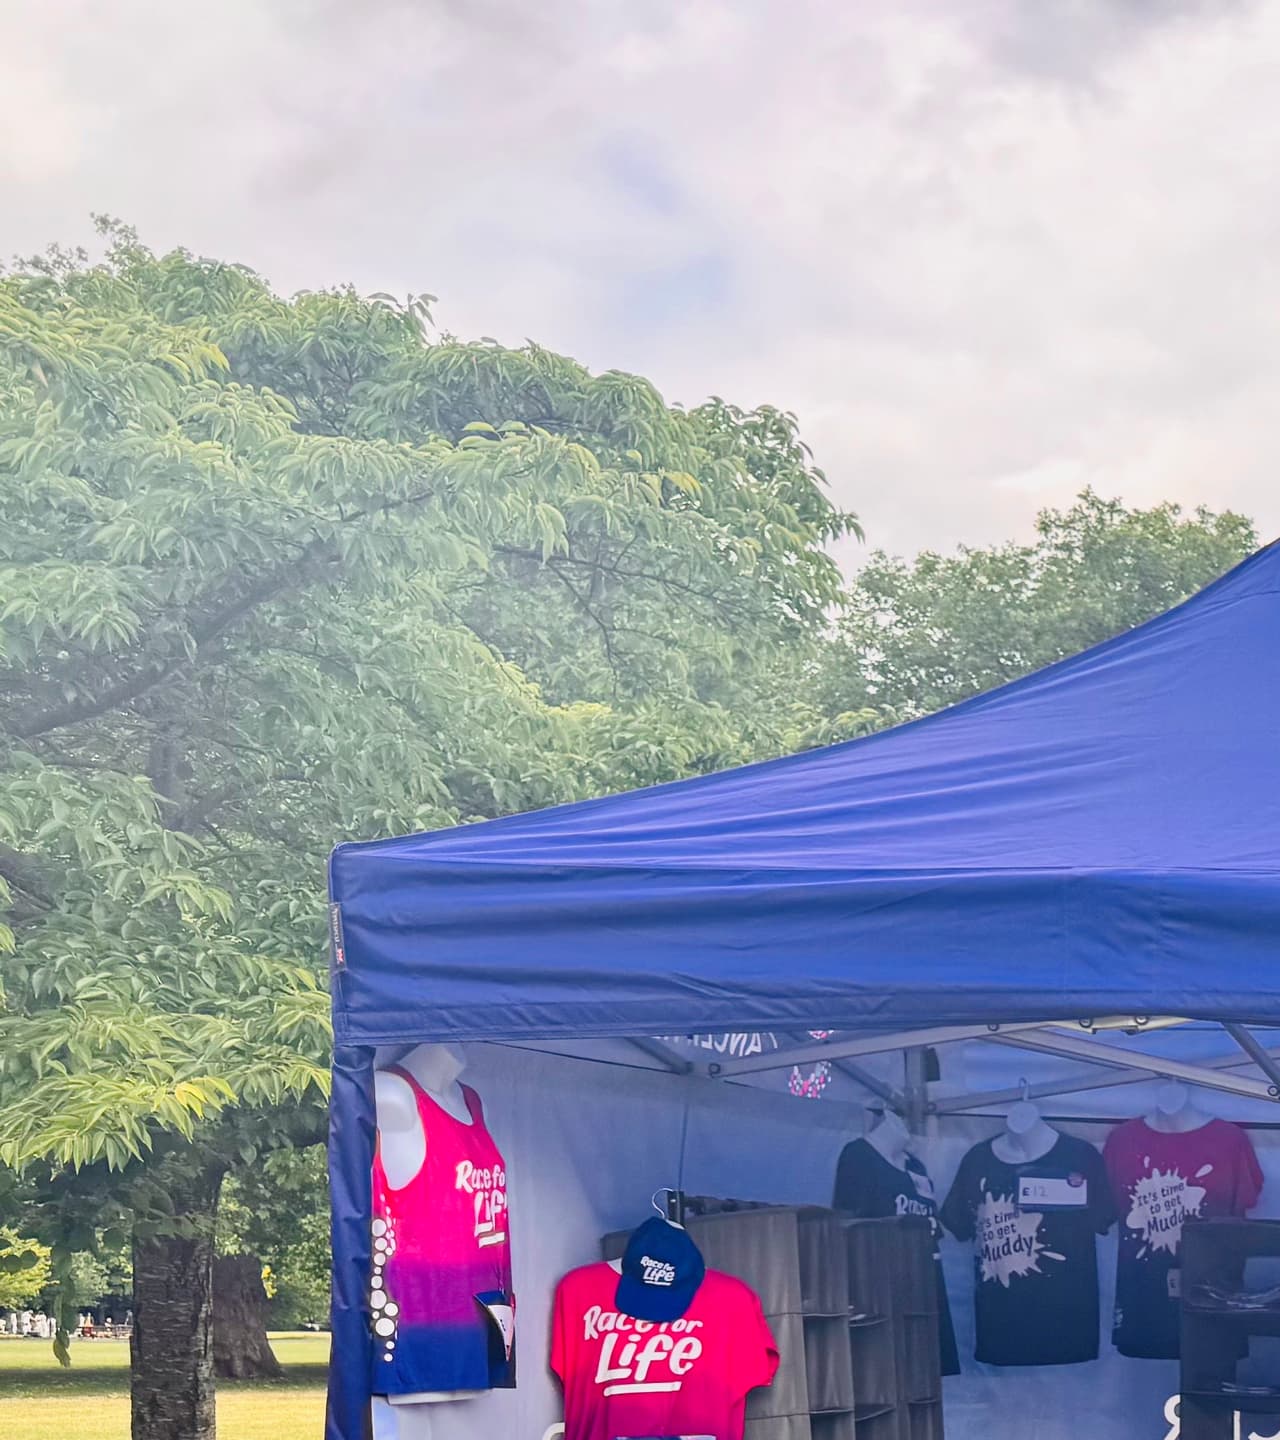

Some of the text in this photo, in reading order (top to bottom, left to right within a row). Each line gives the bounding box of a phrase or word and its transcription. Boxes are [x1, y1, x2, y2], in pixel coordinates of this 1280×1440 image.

[456, 1160, 505, 1193] Race fo
[1160, 1182, 1185, 1197] time
[475, 1190, 508, 1237] Lif
[1150, 1195, 1182, 1216] to get
[997, 1223, 1017, 1238] get
[643, 1267, 675, 1282] Life
[594, 1332, 702, 1384] Life
